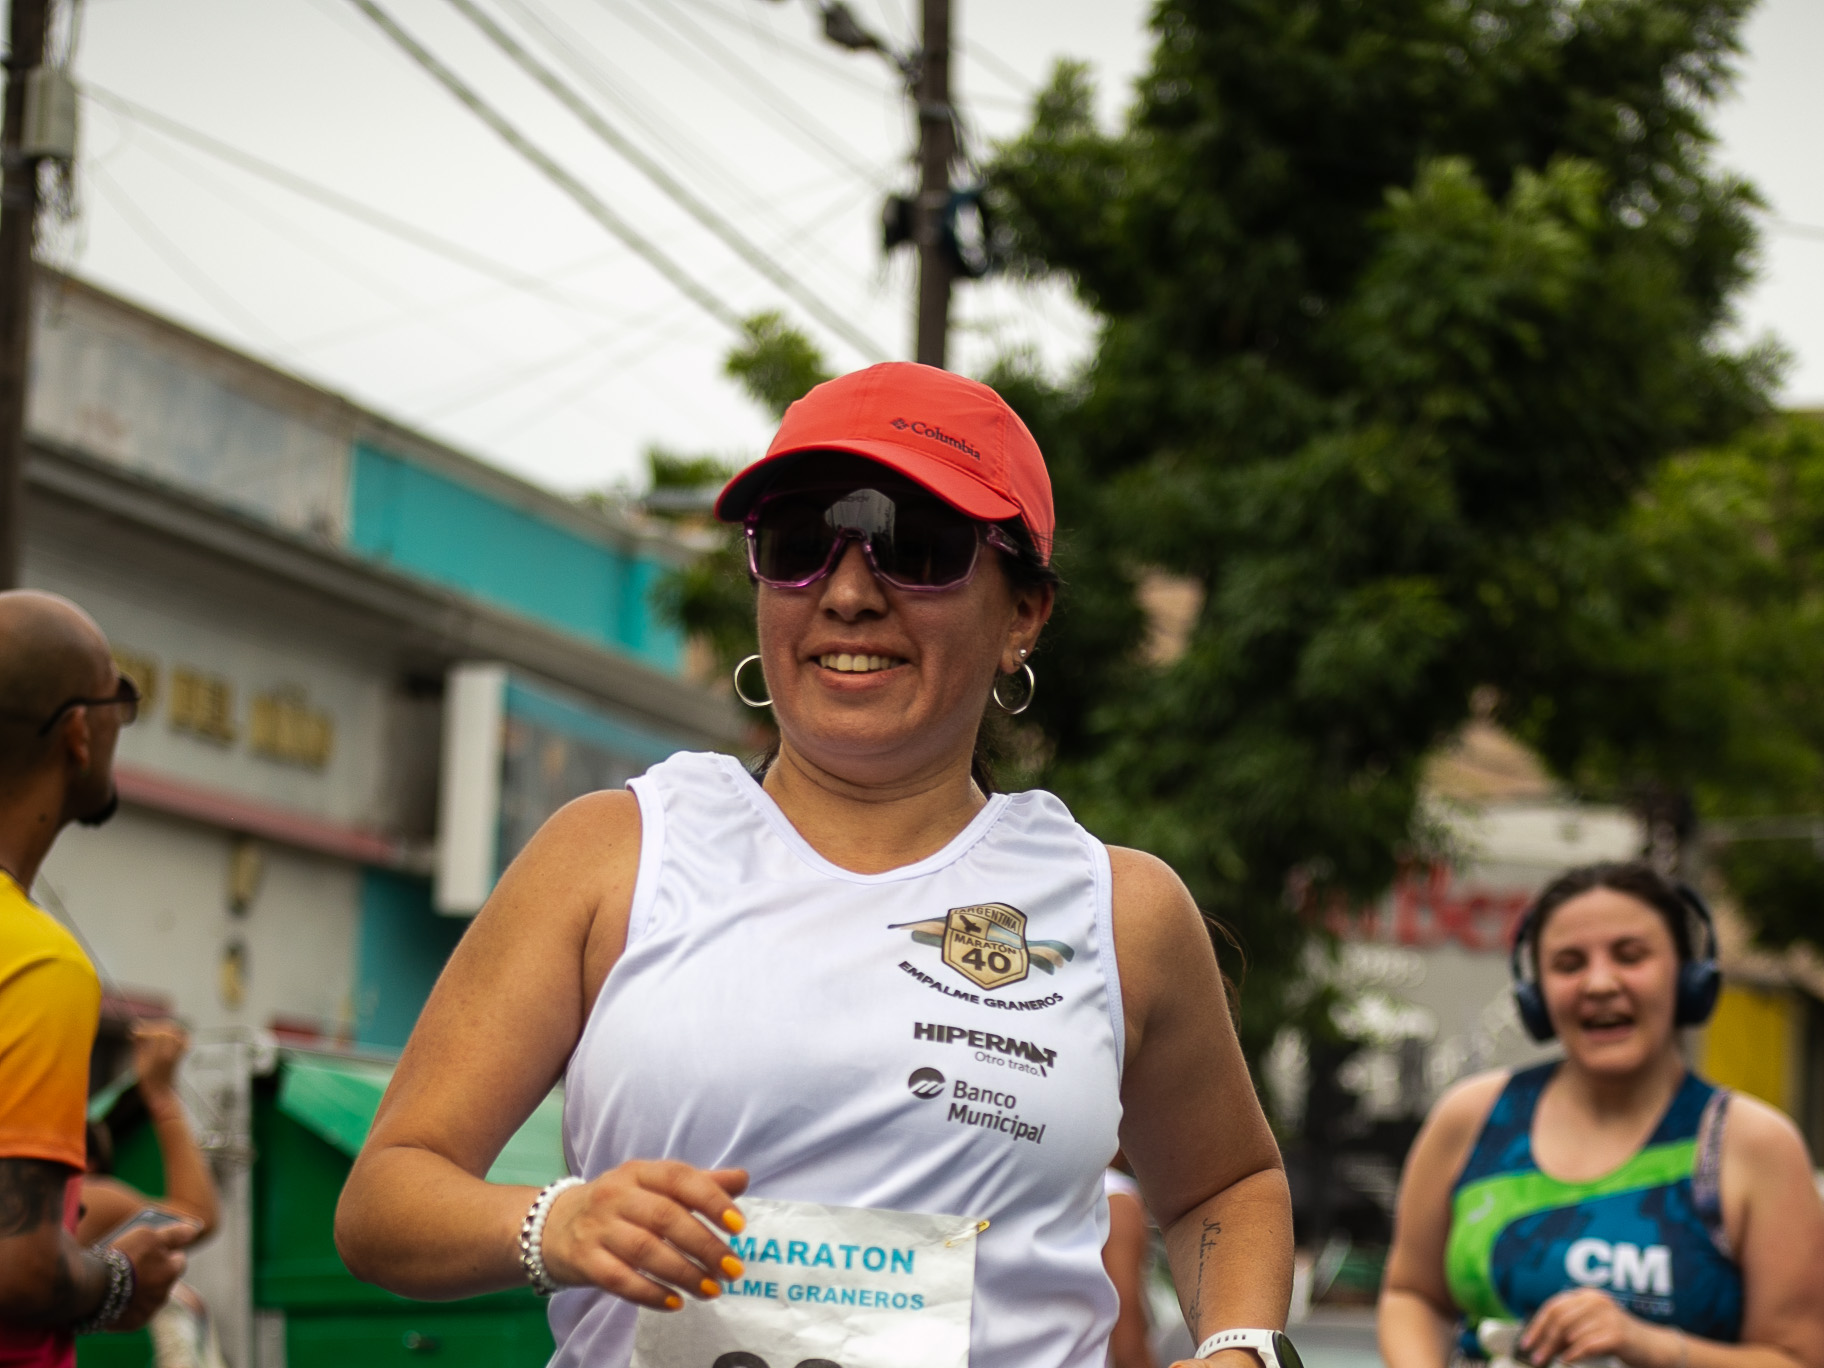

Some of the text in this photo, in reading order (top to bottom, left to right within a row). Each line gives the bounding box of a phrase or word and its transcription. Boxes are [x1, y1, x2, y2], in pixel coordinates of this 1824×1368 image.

[911, 421, 981, 461] Columbia
[953, 933, 1017, 956] MARATÓN
[961, 948, 1012, 975] 40
[898, 960, 1064, 1012] EMPALME GRANEROS
[974, 1050, 1005, 1067] Otro
[952, 1079, 1017, 1110] Banco
[947, 1102, 1047, 1145] Municipal
[728, 1234, 916, 1275] MARATON
[1564, 1236, 1673, 1297] CM
[787, 1283, 925, 1311] GRANEROS
